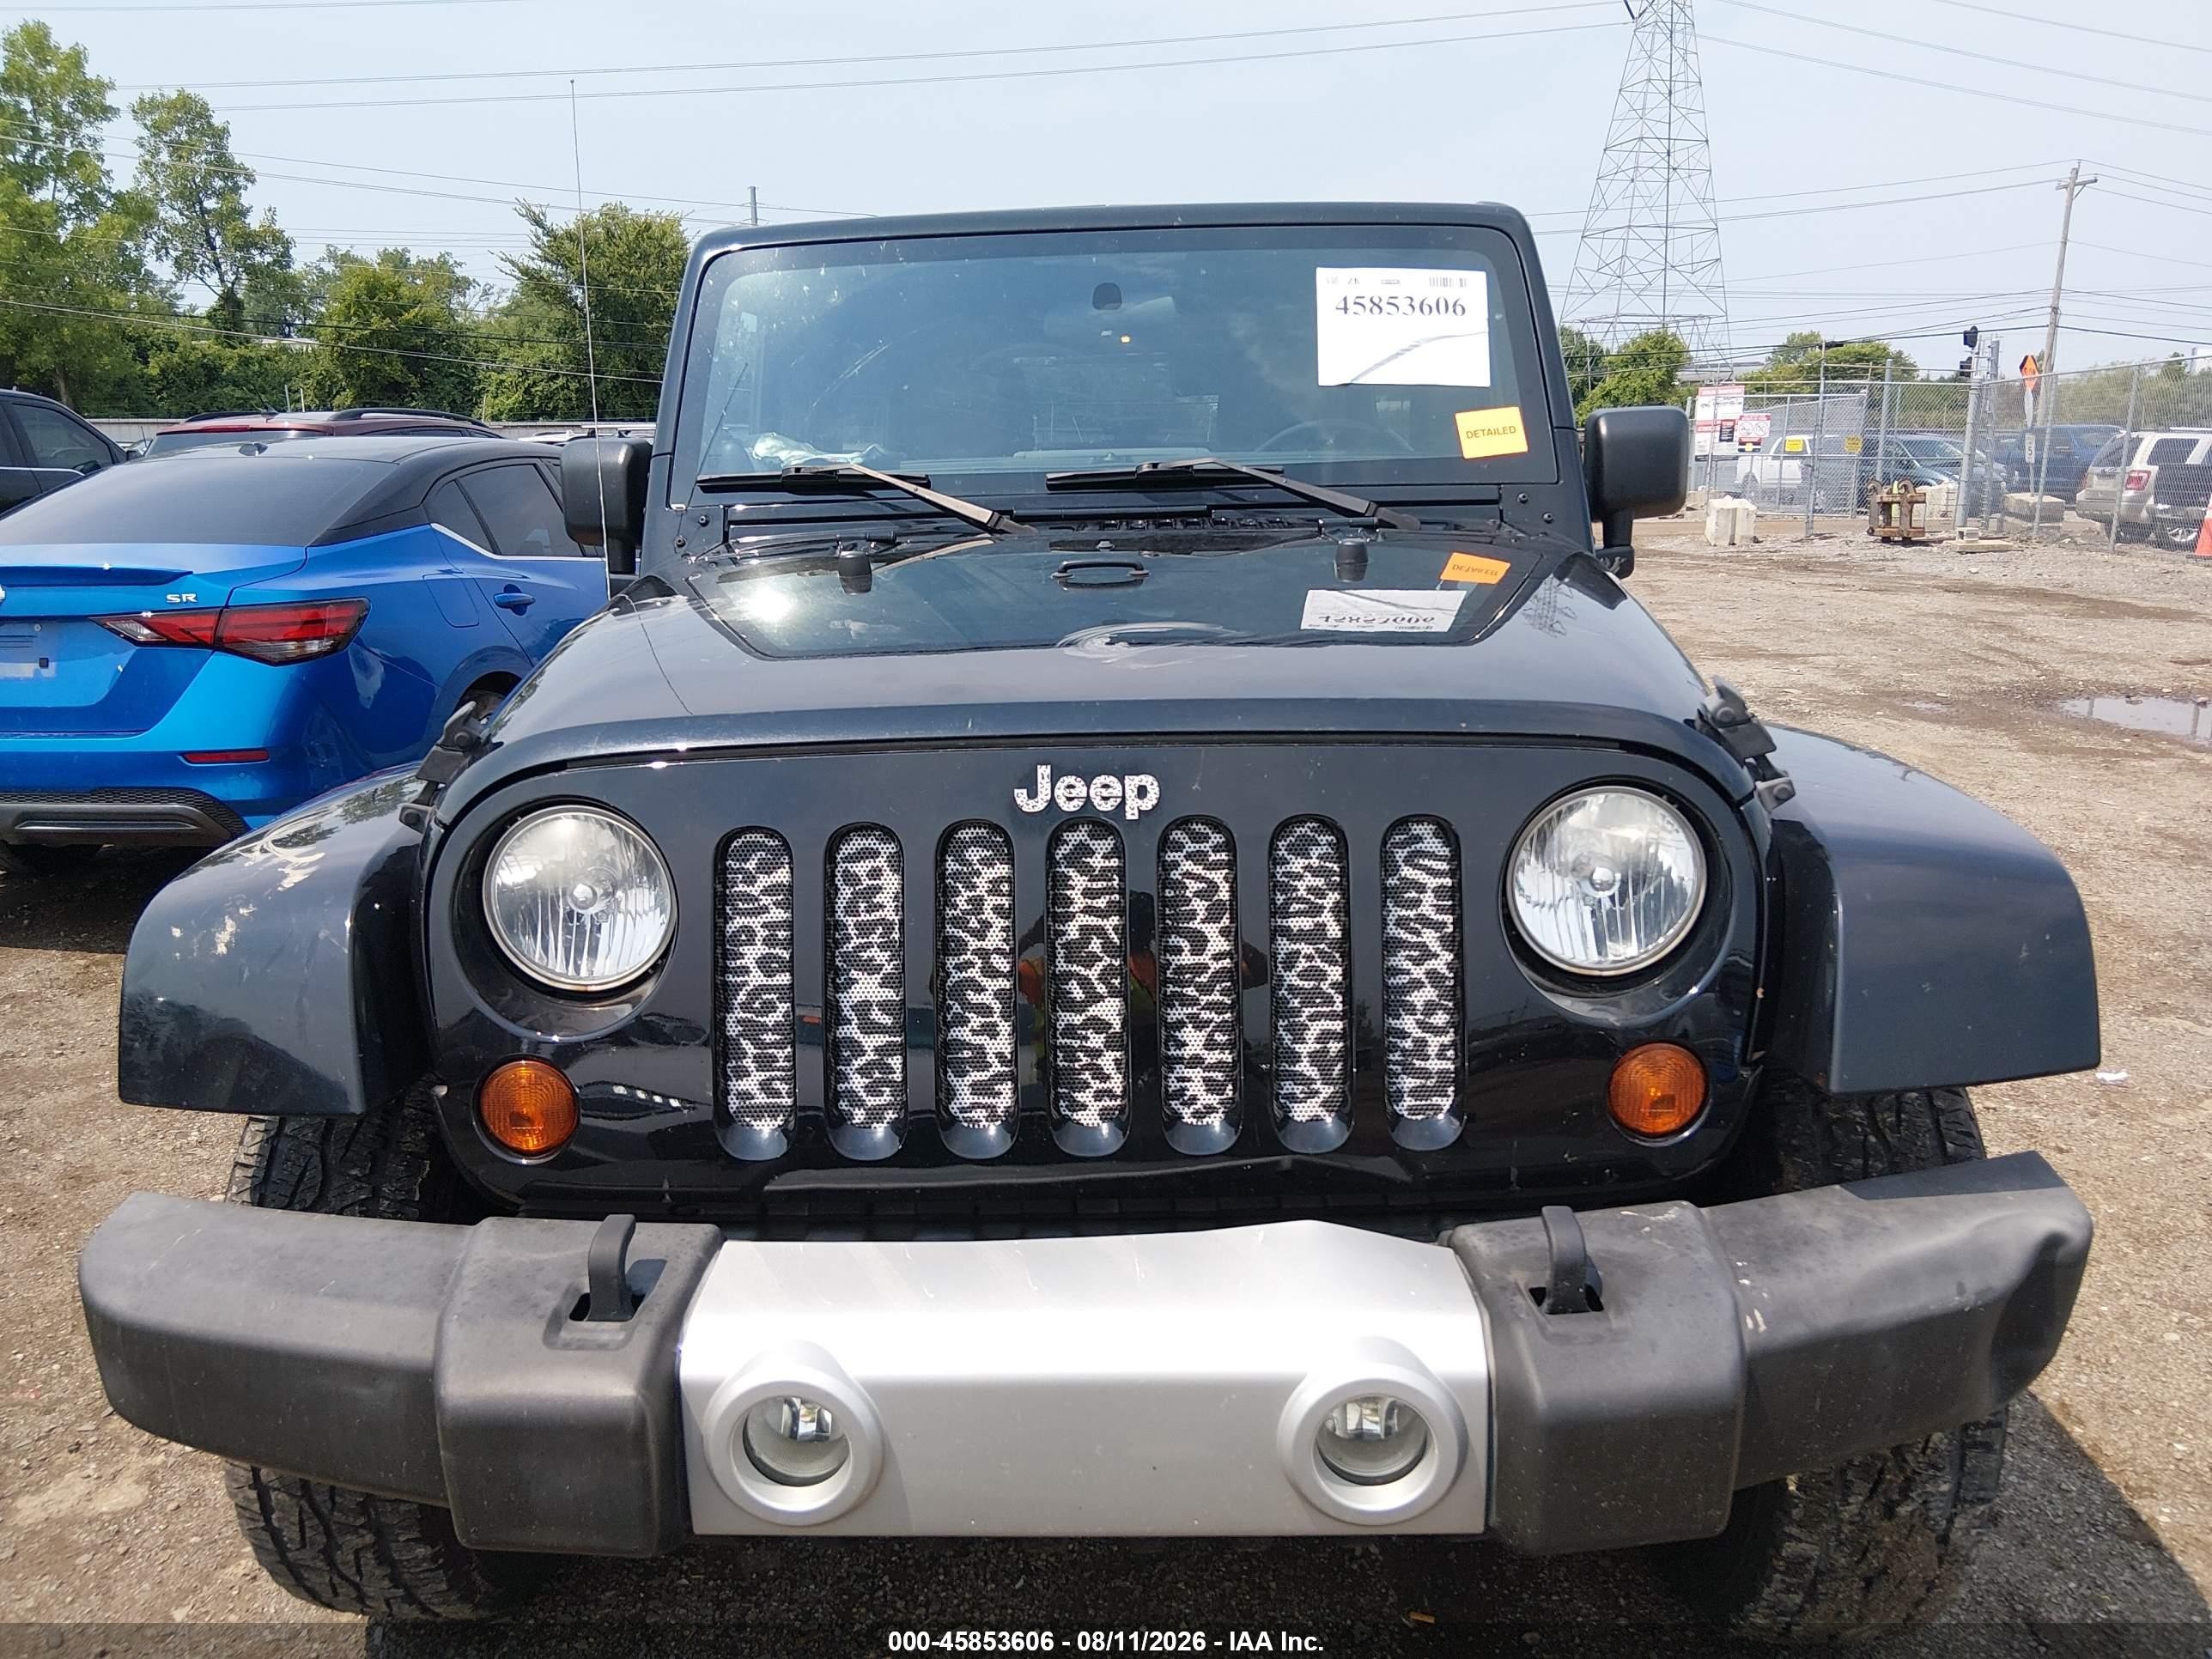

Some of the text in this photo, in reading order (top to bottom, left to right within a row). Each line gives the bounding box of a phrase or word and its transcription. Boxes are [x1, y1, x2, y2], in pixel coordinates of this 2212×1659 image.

[1335, 295, 1467, 316] 45853606
[1466, 425, 1516, 439] DETAILED
[166, 593, 198, 604] SR
[1014, 765, 1159, 819] Jeep
